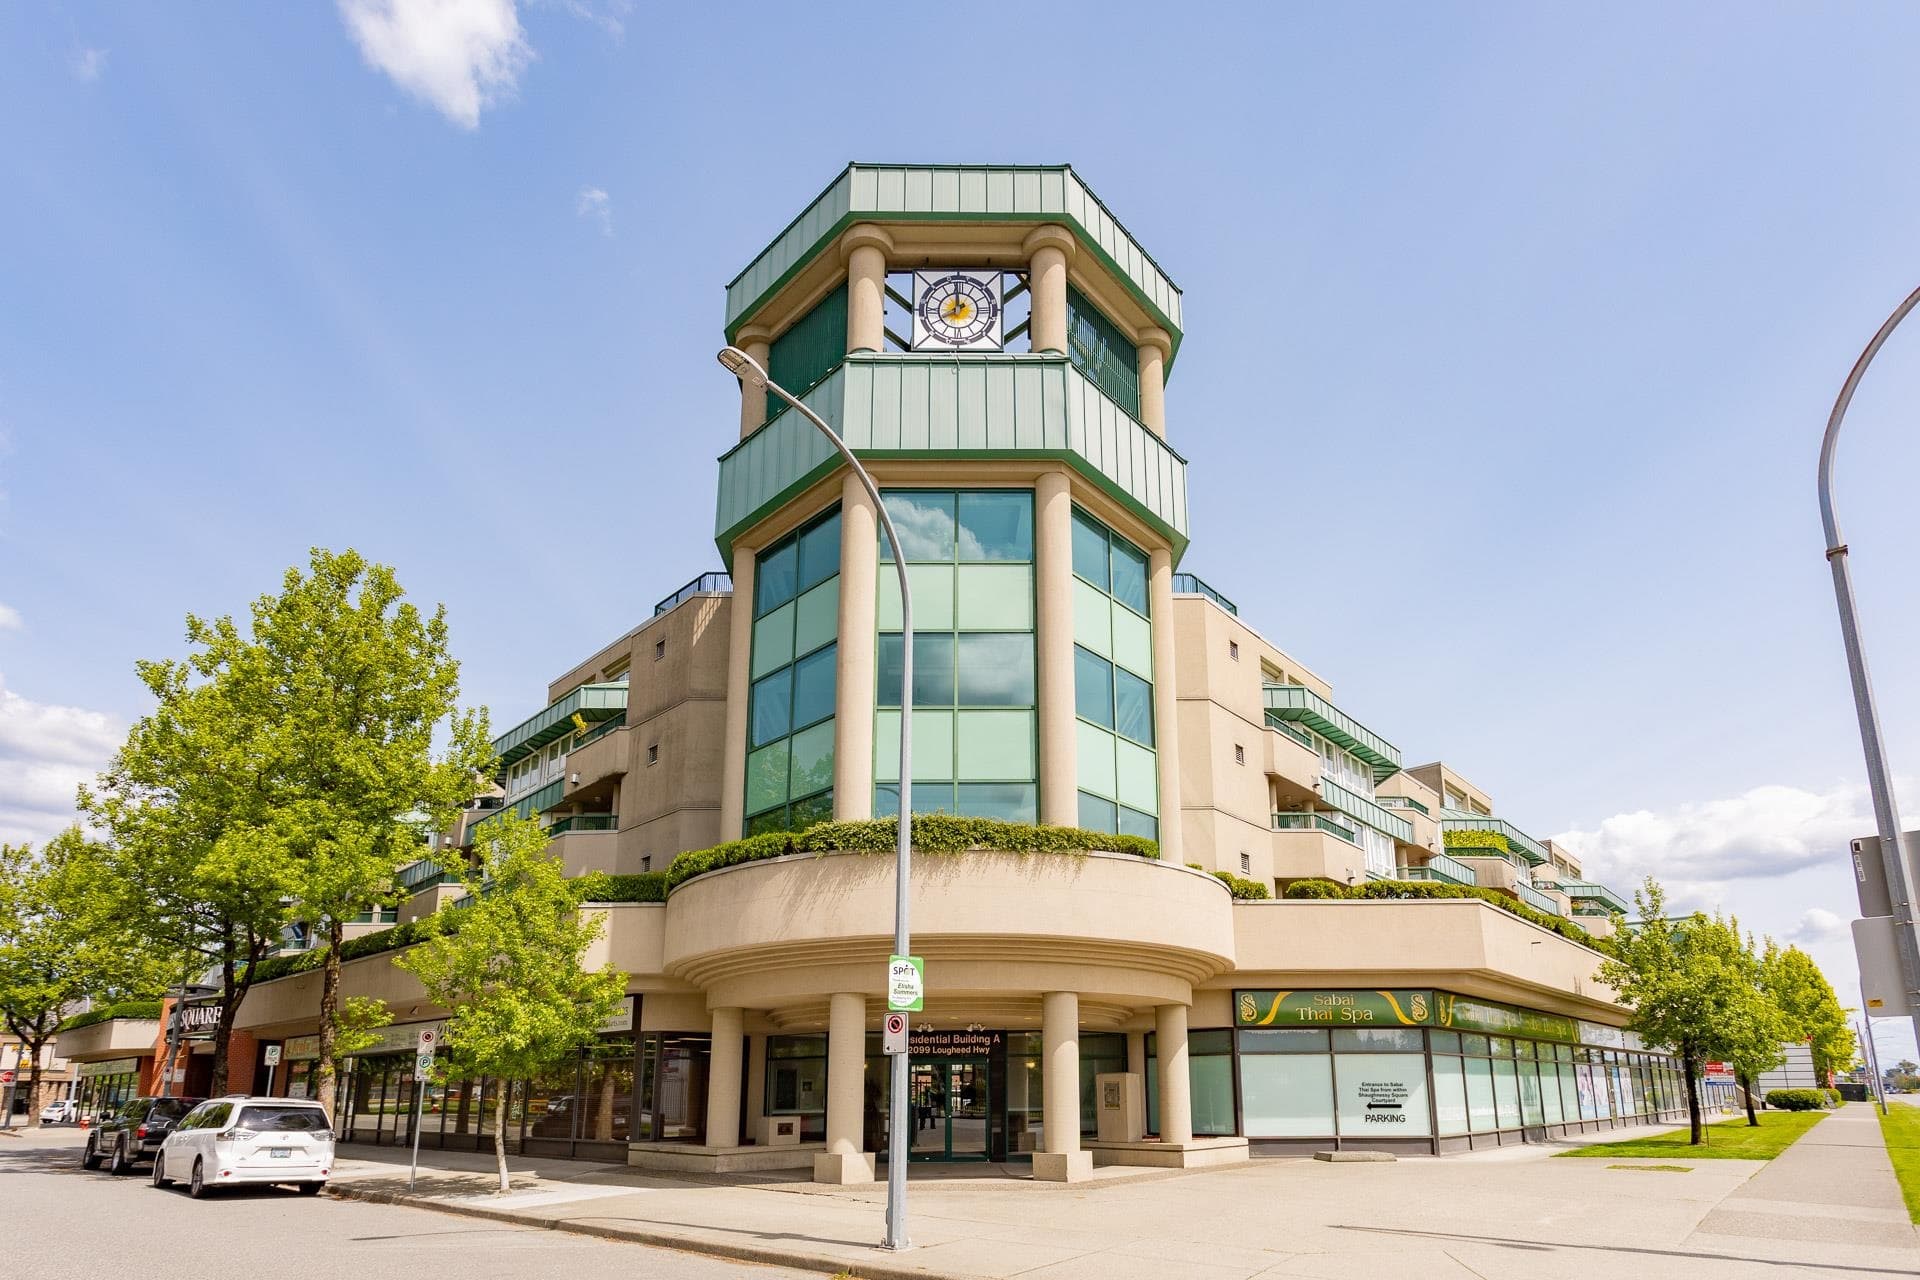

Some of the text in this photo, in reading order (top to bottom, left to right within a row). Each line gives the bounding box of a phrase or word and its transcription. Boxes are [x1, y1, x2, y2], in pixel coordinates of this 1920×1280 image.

[1313, 994, 1354, 1006] Sabai
[180, 1006, 223, 1030] SQUARE
[1295, 1007, 1373, 1023] Thai Spa
[909, 1033, 1001, 1046] sidential Building A
[908, 1045, 990, 1055] 2099 Lougheed Hwy
[1365, 1114, 1406, 1123] PARKING
